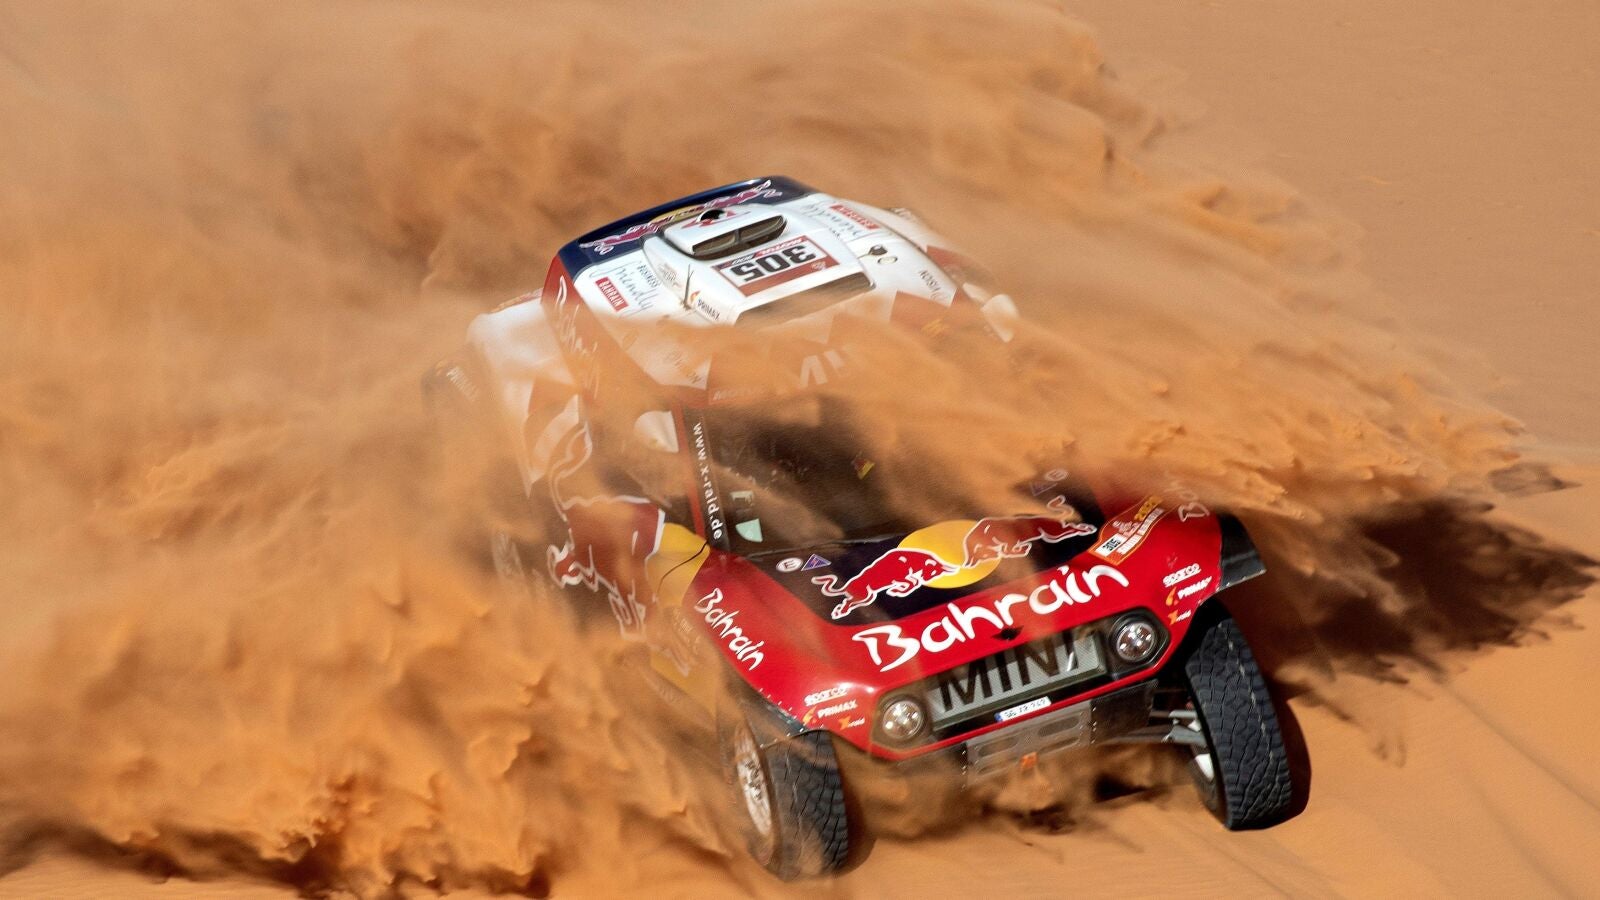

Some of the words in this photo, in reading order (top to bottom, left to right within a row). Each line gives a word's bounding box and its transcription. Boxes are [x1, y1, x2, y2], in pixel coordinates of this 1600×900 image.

[730, 245, 816, 282] 305
[601, 281, 624, 308] BAHRAIN
[693, 422, 723, 540] www.x-raid.de
[1102, 538, 1121, 551] 305
[694, 588, 764, 670] Bahrain
[852, 565, 1129, 672] Bahrain
[938, 627, 1079, 712] MINI
[817, 700, 857, 718] PRIMAX
